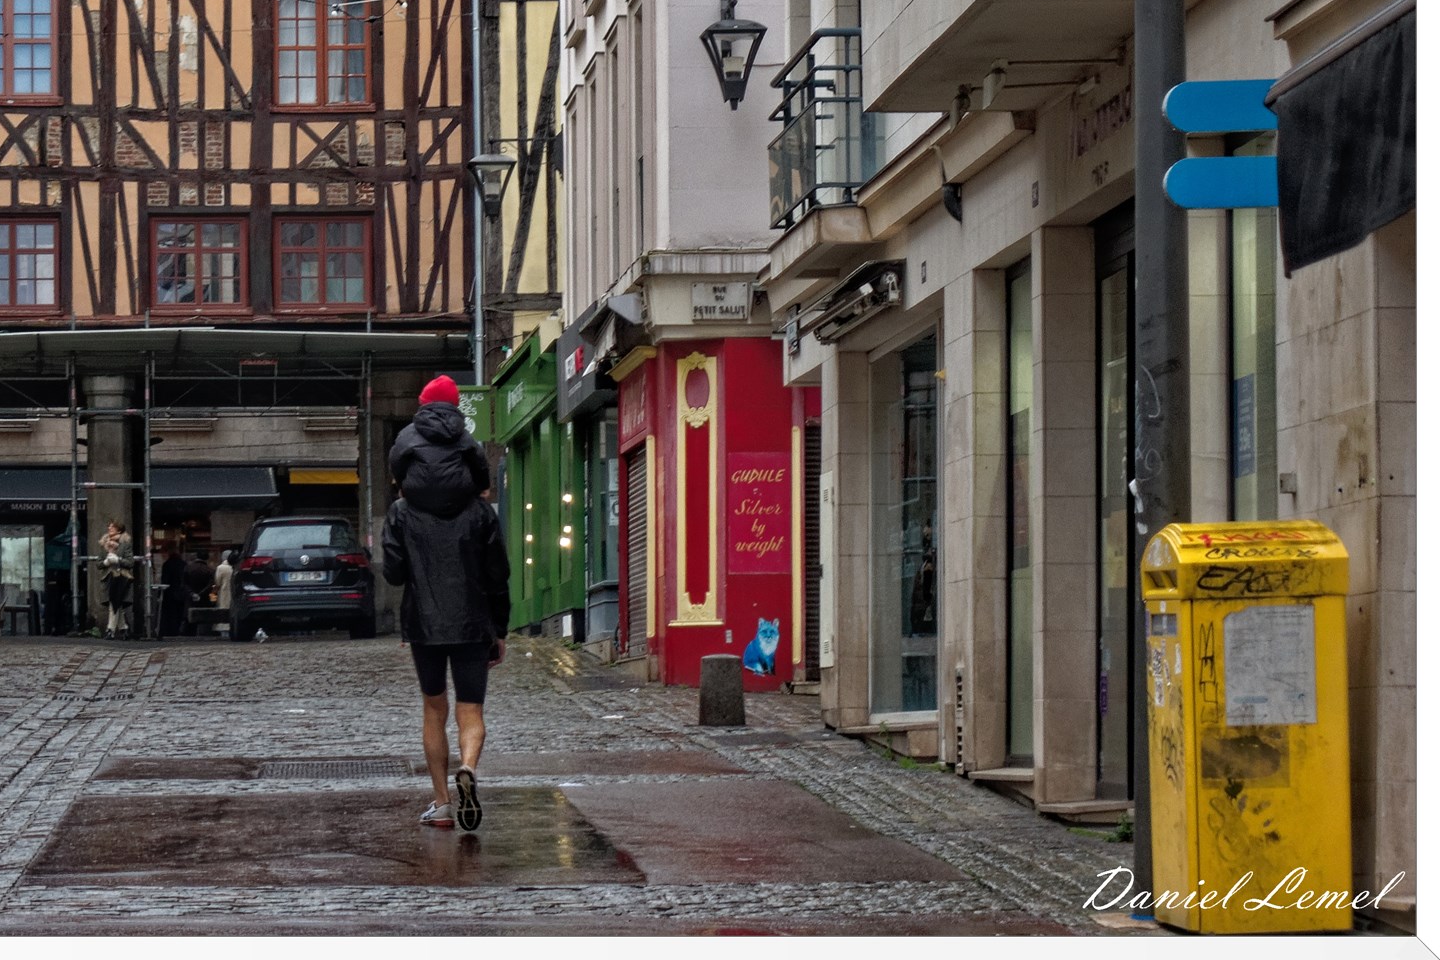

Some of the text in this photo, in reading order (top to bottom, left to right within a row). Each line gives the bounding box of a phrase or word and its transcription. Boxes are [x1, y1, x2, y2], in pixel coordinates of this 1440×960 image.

[694, 306, 745, 314] PETIT SALUT
[731, 468, 786, 484] GUDULE
[10, 503, 42, 511] MAISON
[46, 503, 58, 511] DE
[734, 499, 783, 515] Silver
[751, 518, 766, 537] by
[735, 536, 784, 558] weight
